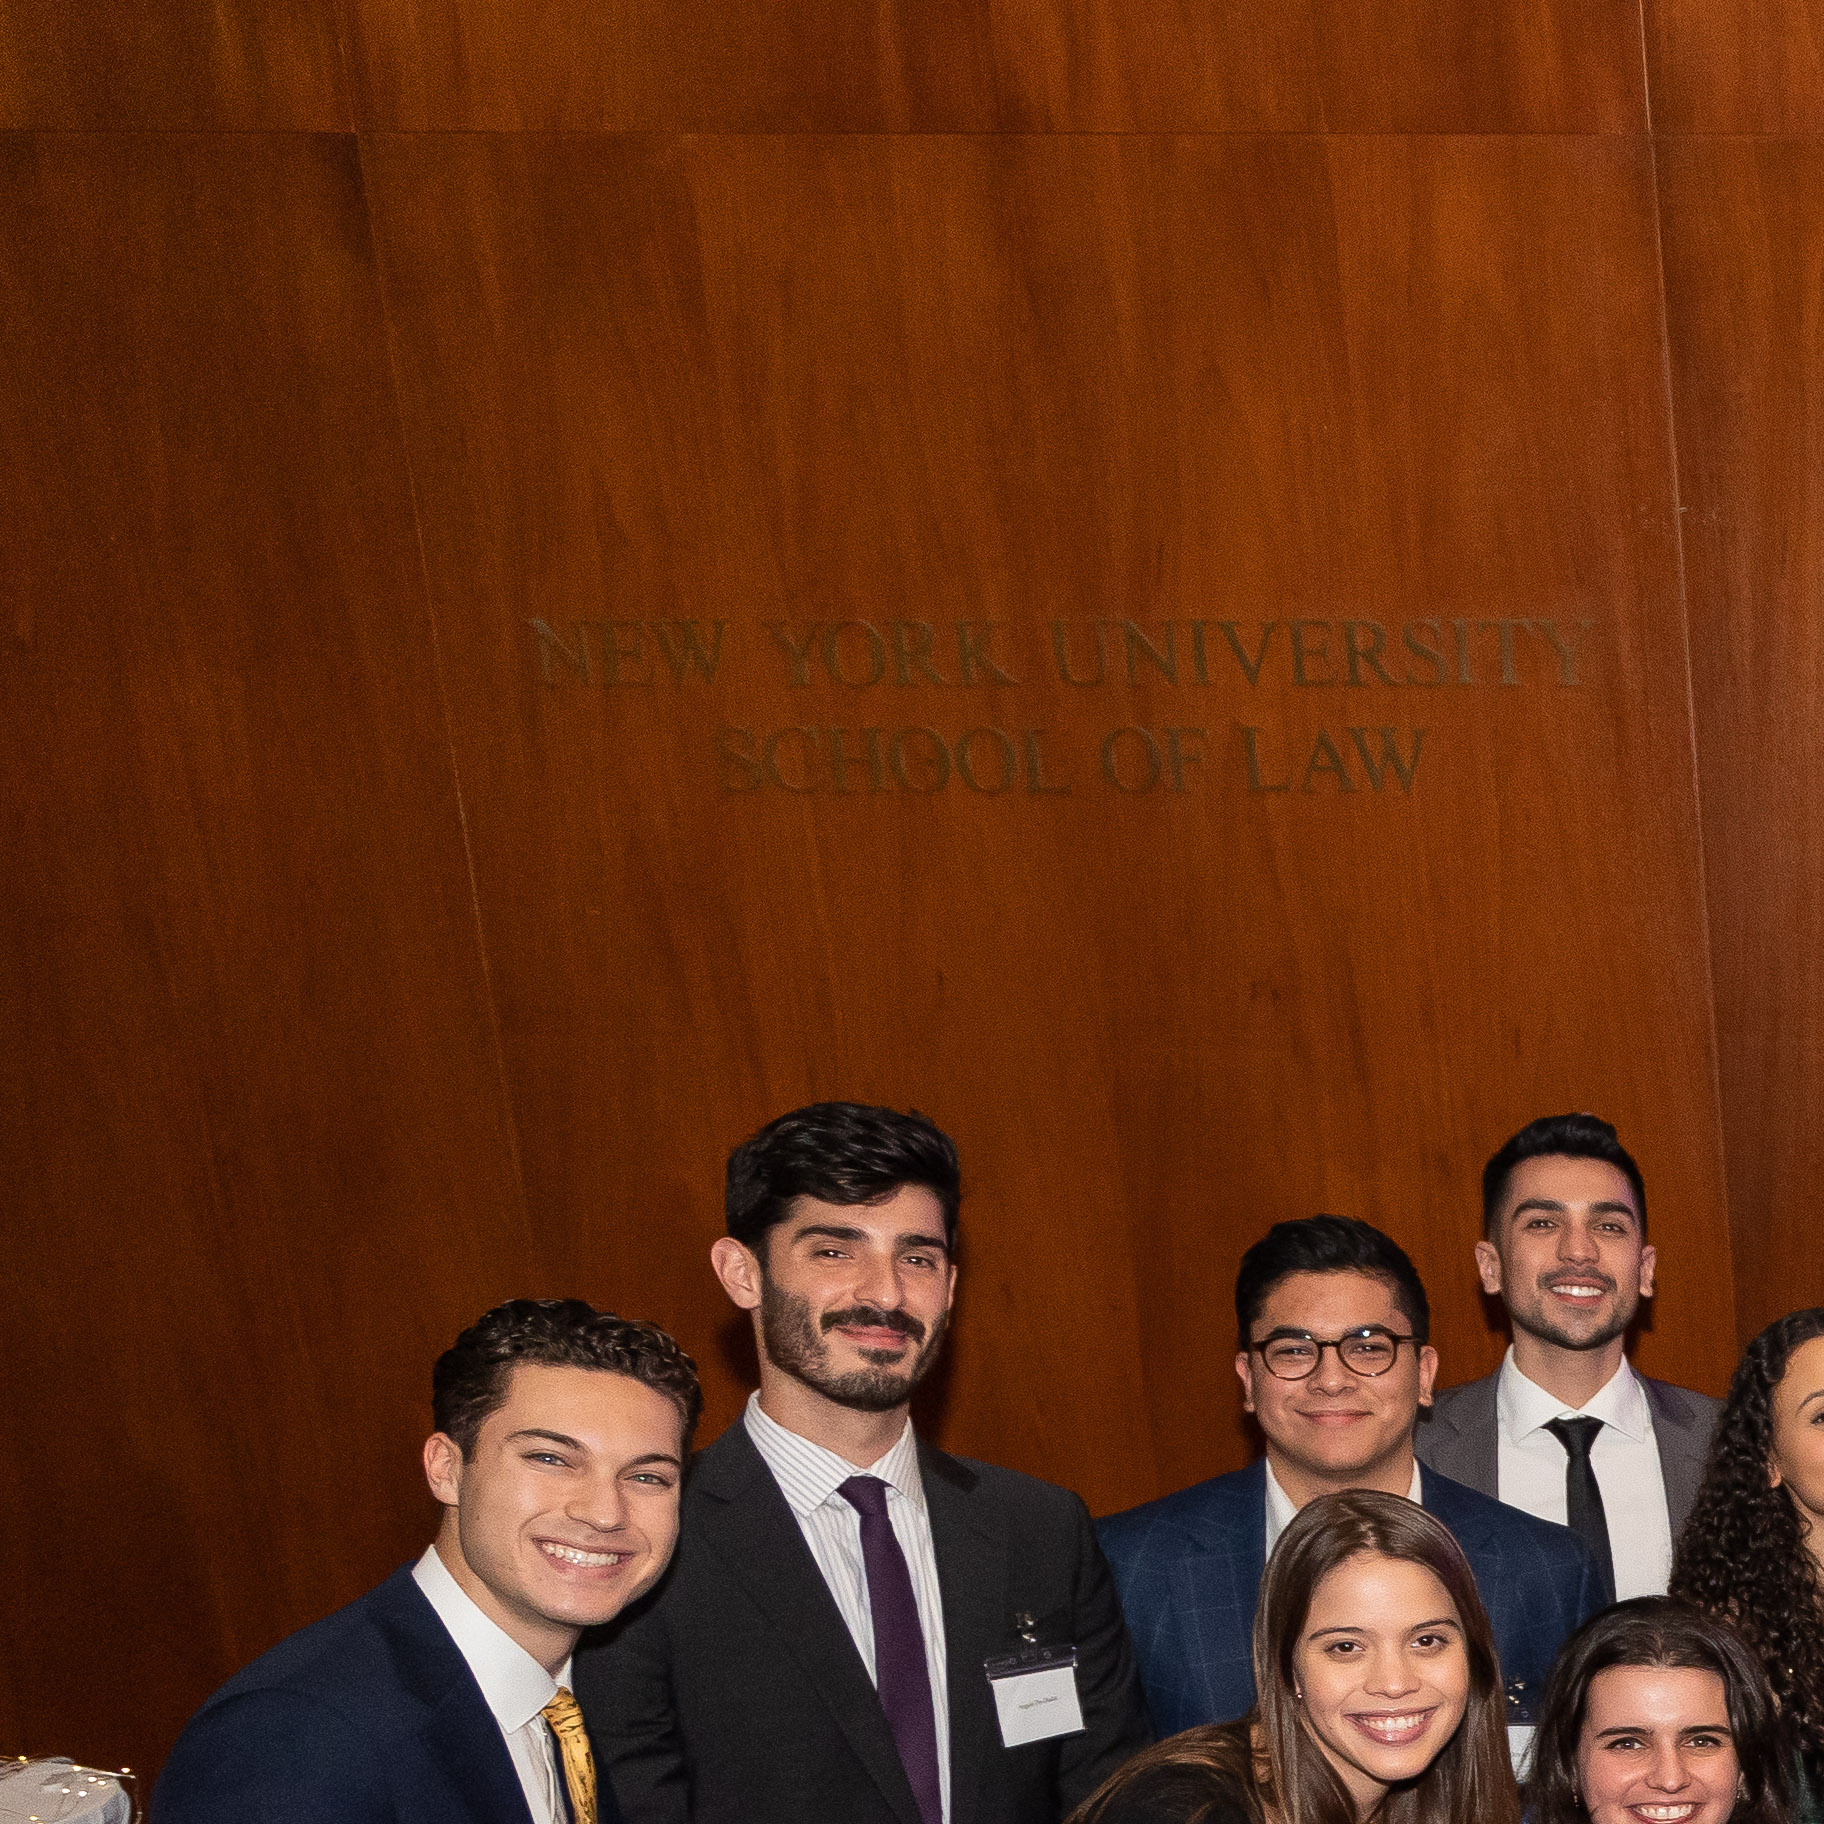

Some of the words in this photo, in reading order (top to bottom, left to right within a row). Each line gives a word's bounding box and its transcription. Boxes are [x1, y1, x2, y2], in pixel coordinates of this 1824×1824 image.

[526, 616, 727, 685] NEW
[773, 616, 1022, 686] YORK
[1051, 616, 1595, 686] UNIVERSITY
[716, 722, 1073, 792] SCHOOL
[1099, 722, 1214, 792] OF
[1242, 722, 1427, 792] LAW
